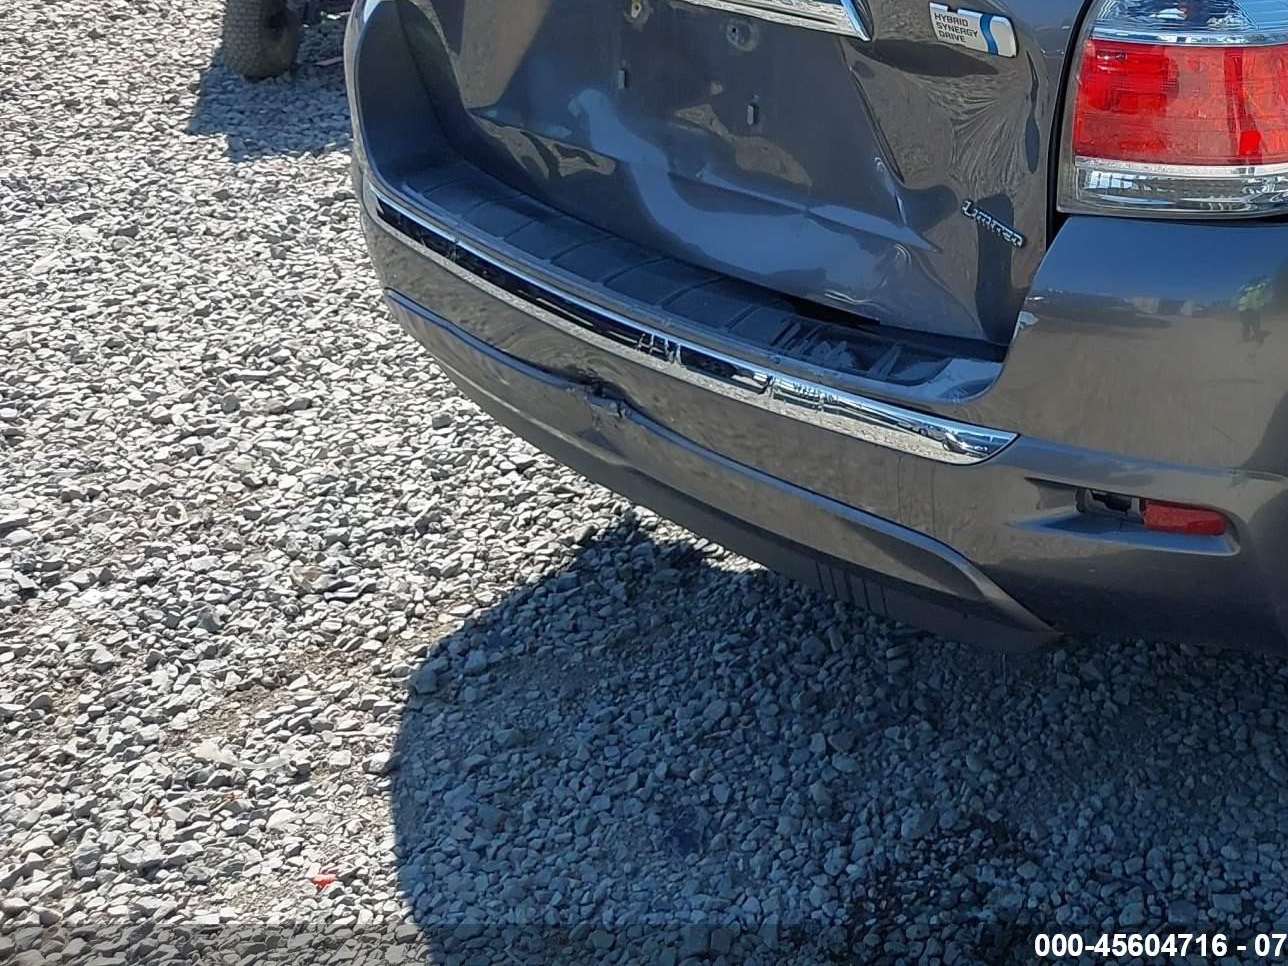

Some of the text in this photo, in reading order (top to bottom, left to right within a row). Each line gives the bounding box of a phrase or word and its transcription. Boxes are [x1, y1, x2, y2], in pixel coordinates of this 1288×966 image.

[934, 12, 969, 27] HYBRID
[936, 21, 979, 38] SYNERGY
[938, 30, 967, 43] DRIVE
